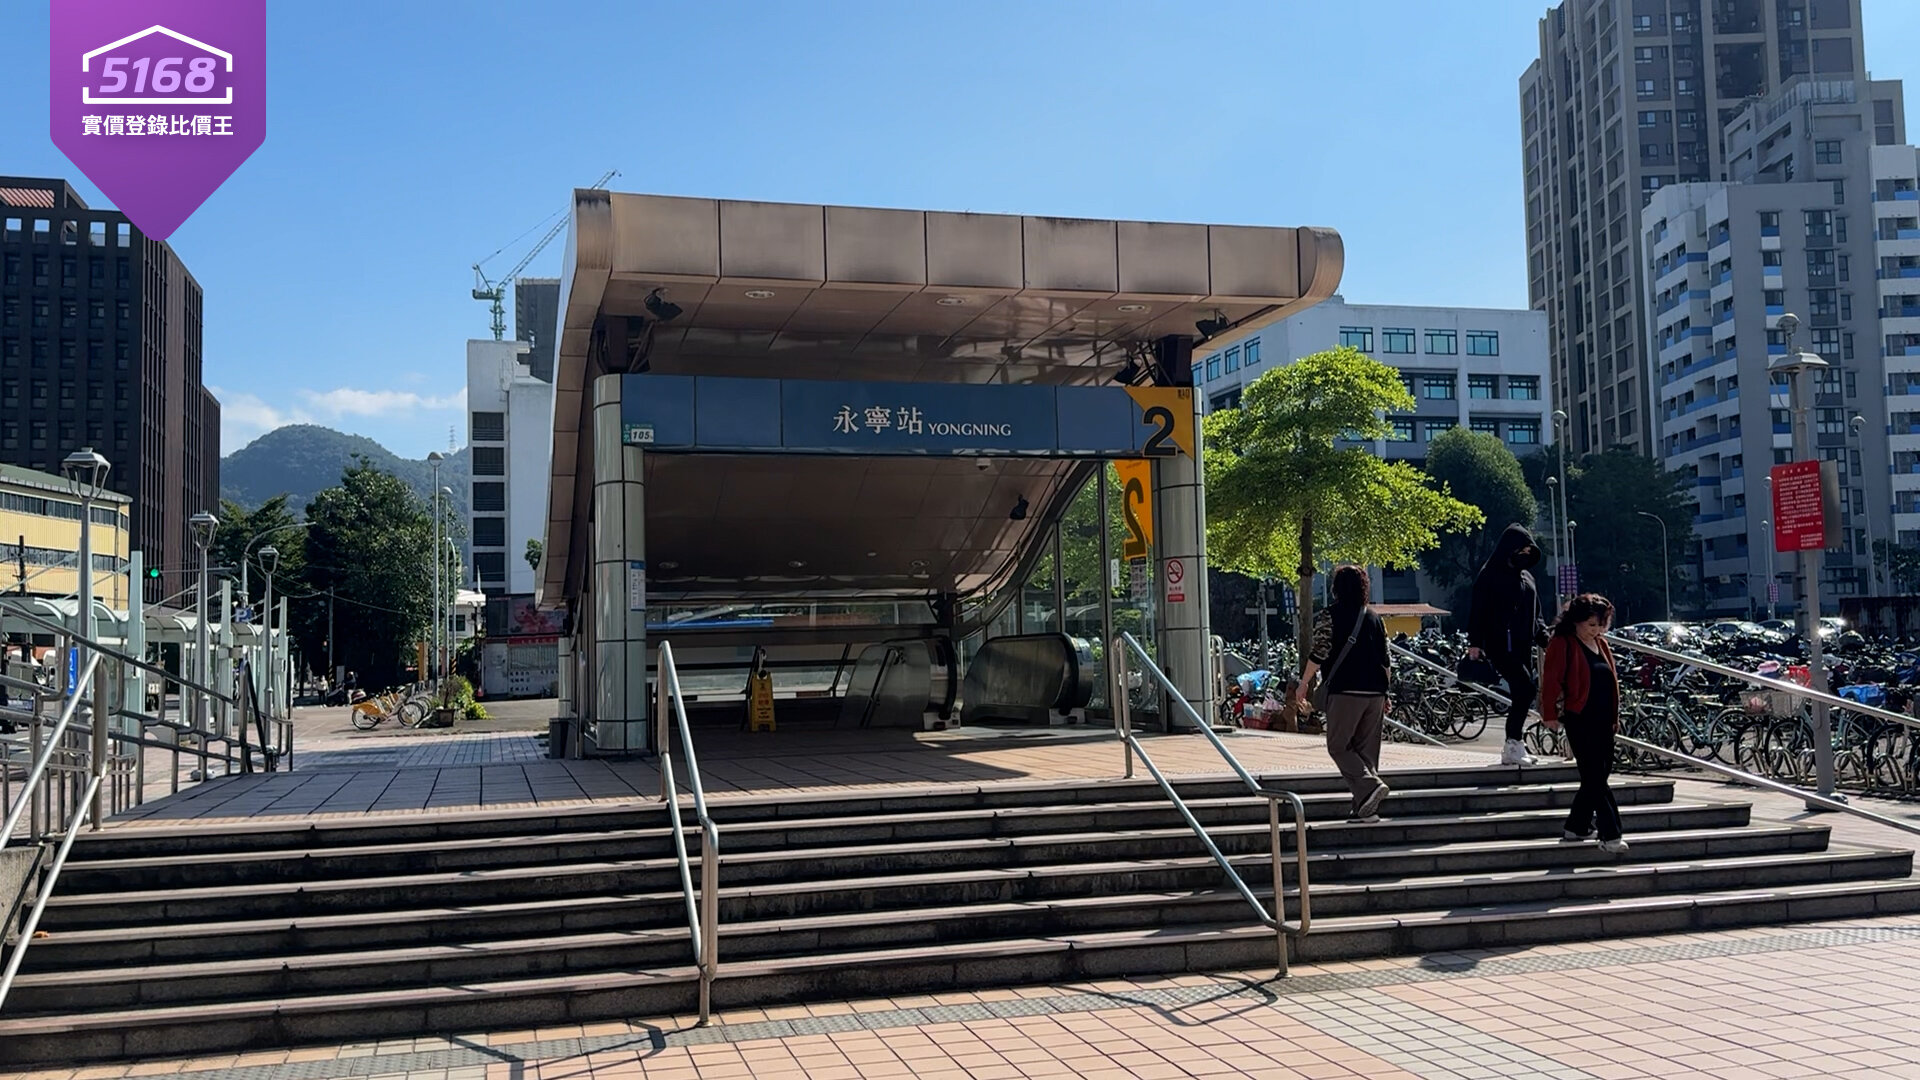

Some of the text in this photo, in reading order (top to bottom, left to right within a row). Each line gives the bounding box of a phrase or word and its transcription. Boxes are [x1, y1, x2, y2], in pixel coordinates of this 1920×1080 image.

[632, 430, 651, 441] 105
[833, 405, 1012, 437] 永寧站 YONGNING
[1143, 406, 1178, 457] 2
